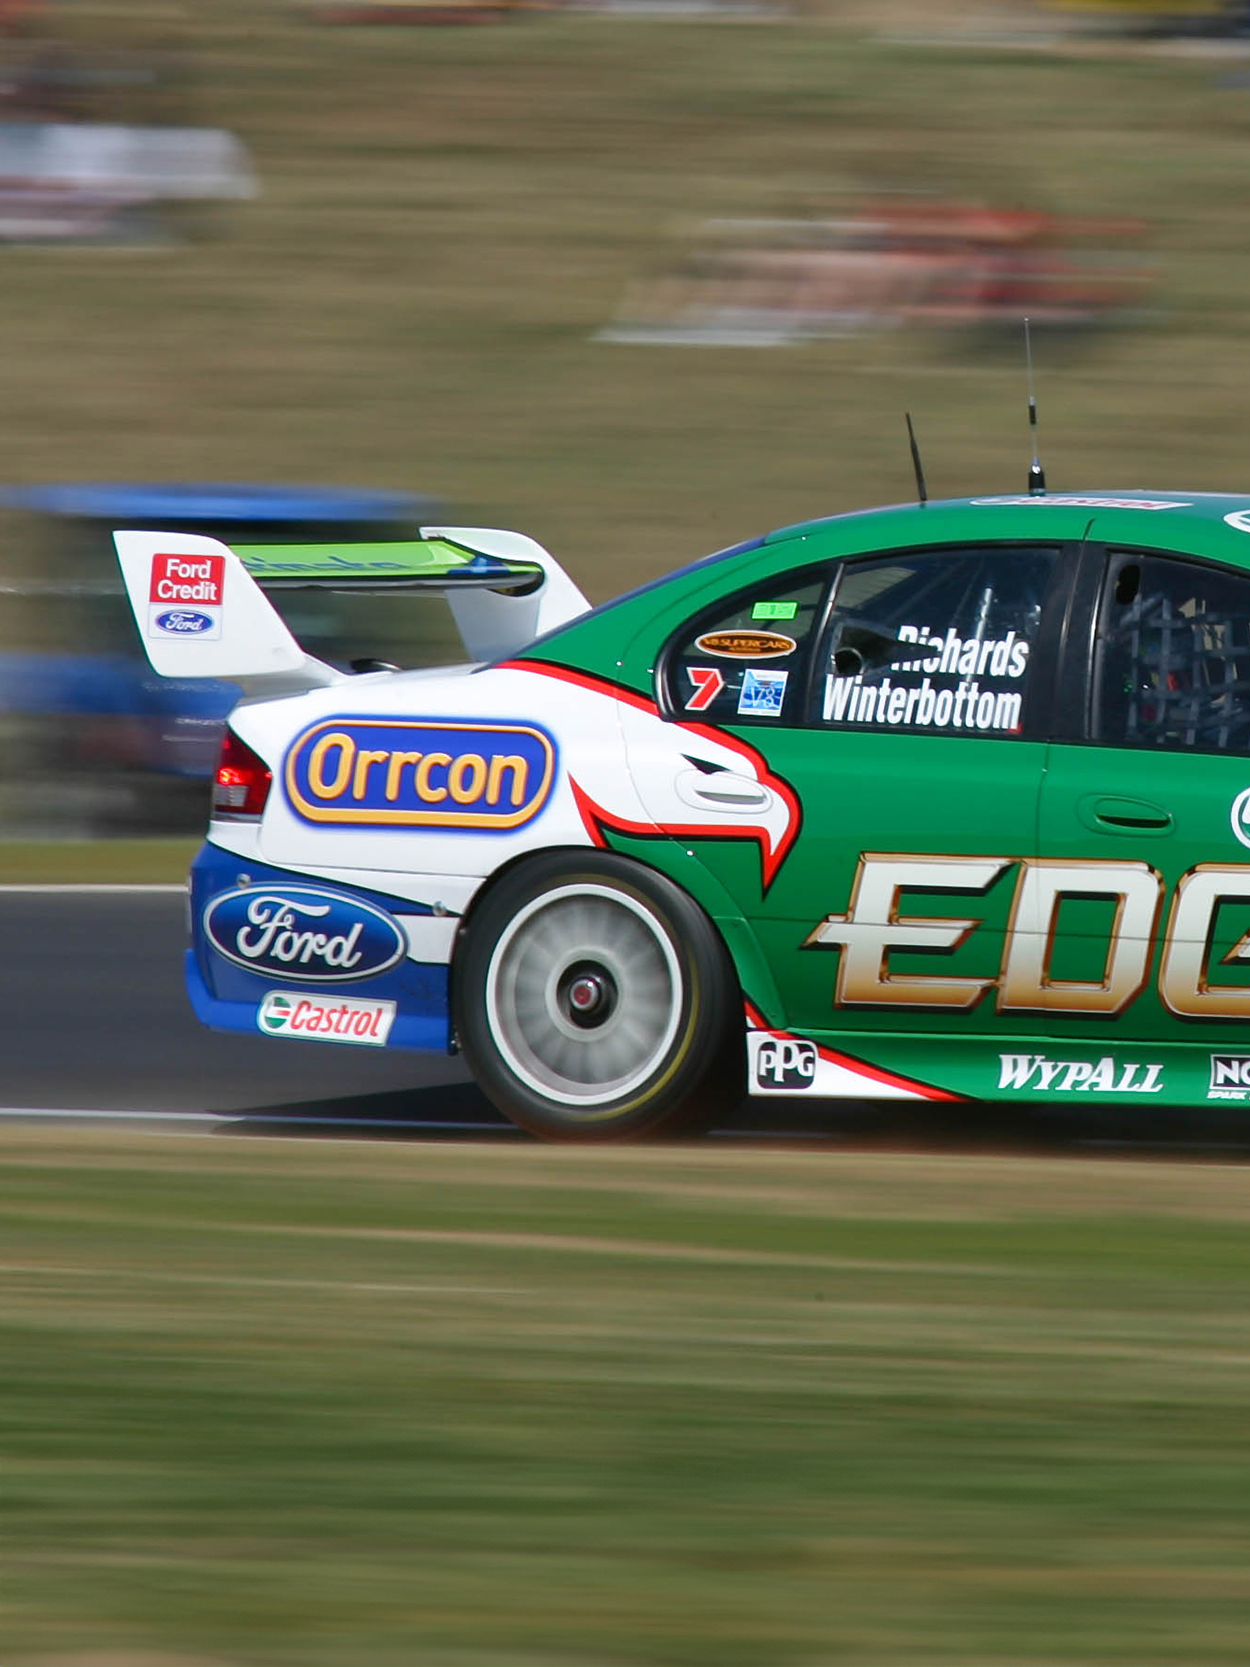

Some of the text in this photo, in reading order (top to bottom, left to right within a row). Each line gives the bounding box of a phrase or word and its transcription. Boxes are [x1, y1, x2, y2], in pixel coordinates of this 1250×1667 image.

[166, 558, 212, 579] Ford
[157, 579, 218, 601] Credit
[165, 612, 204, 631] Ford
[823, 673, 1022, 730] Winterbottom
[308, 733, 528, 806] Orrcon
[237, 895, 363, 968] Ford
[290, 1000, 384, 1037] Castrol
[758, 1043, 814, 1082] PPG
[1207, 1091, 1247, 1100] SPARK
